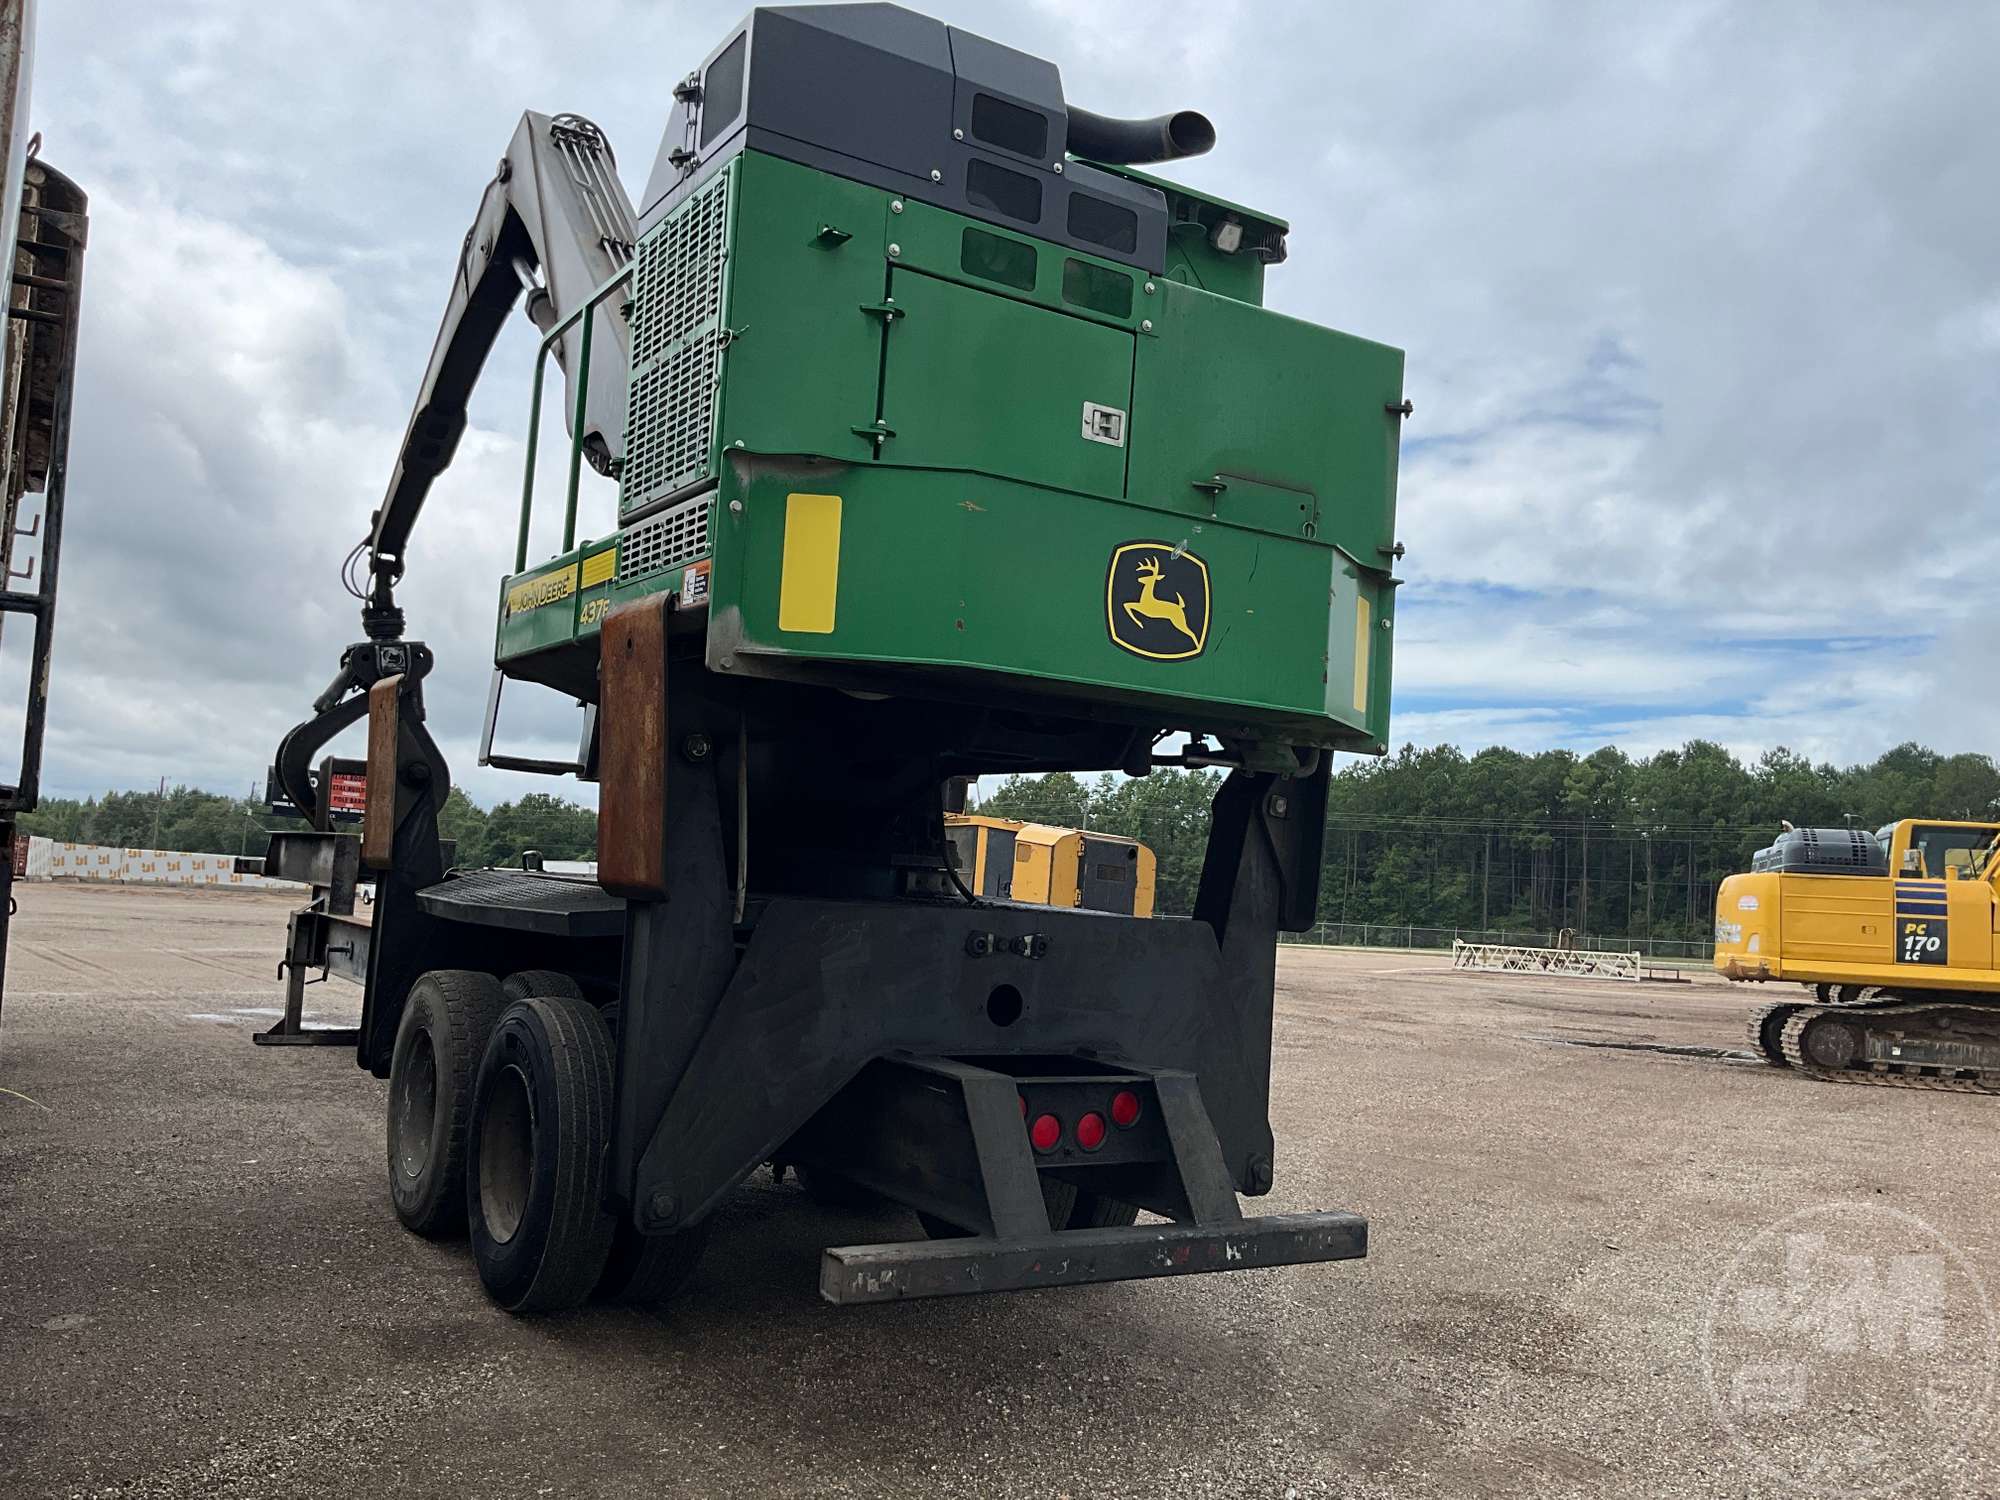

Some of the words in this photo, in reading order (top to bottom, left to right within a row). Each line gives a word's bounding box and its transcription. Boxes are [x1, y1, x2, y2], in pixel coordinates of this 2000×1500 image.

[518, 583, 540, 612] JOHN
[540, 579, 569, 605] DEERE
[1904, 923, 1927, 935] PC
[1904, 935, 1941, 952] 170
[1904, 951, 1921, 961] LC
